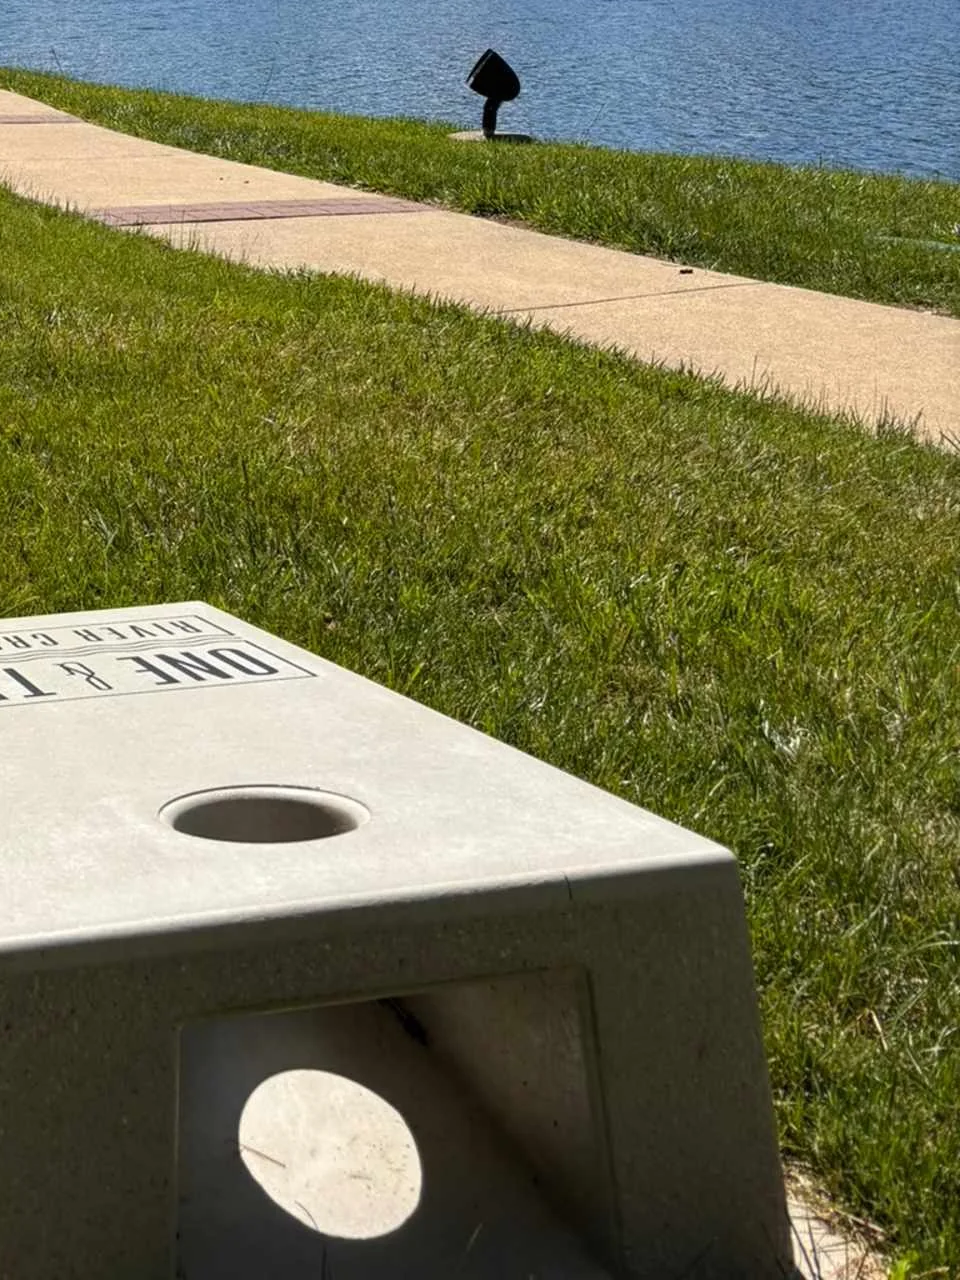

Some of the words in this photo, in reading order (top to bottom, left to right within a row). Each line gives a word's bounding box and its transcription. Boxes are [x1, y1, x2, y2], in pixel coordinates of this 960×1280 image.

[73, 620, 203, 642] RIVER
[52, 661, 113, 691] &
[116, 648, 280, 685] ONE
